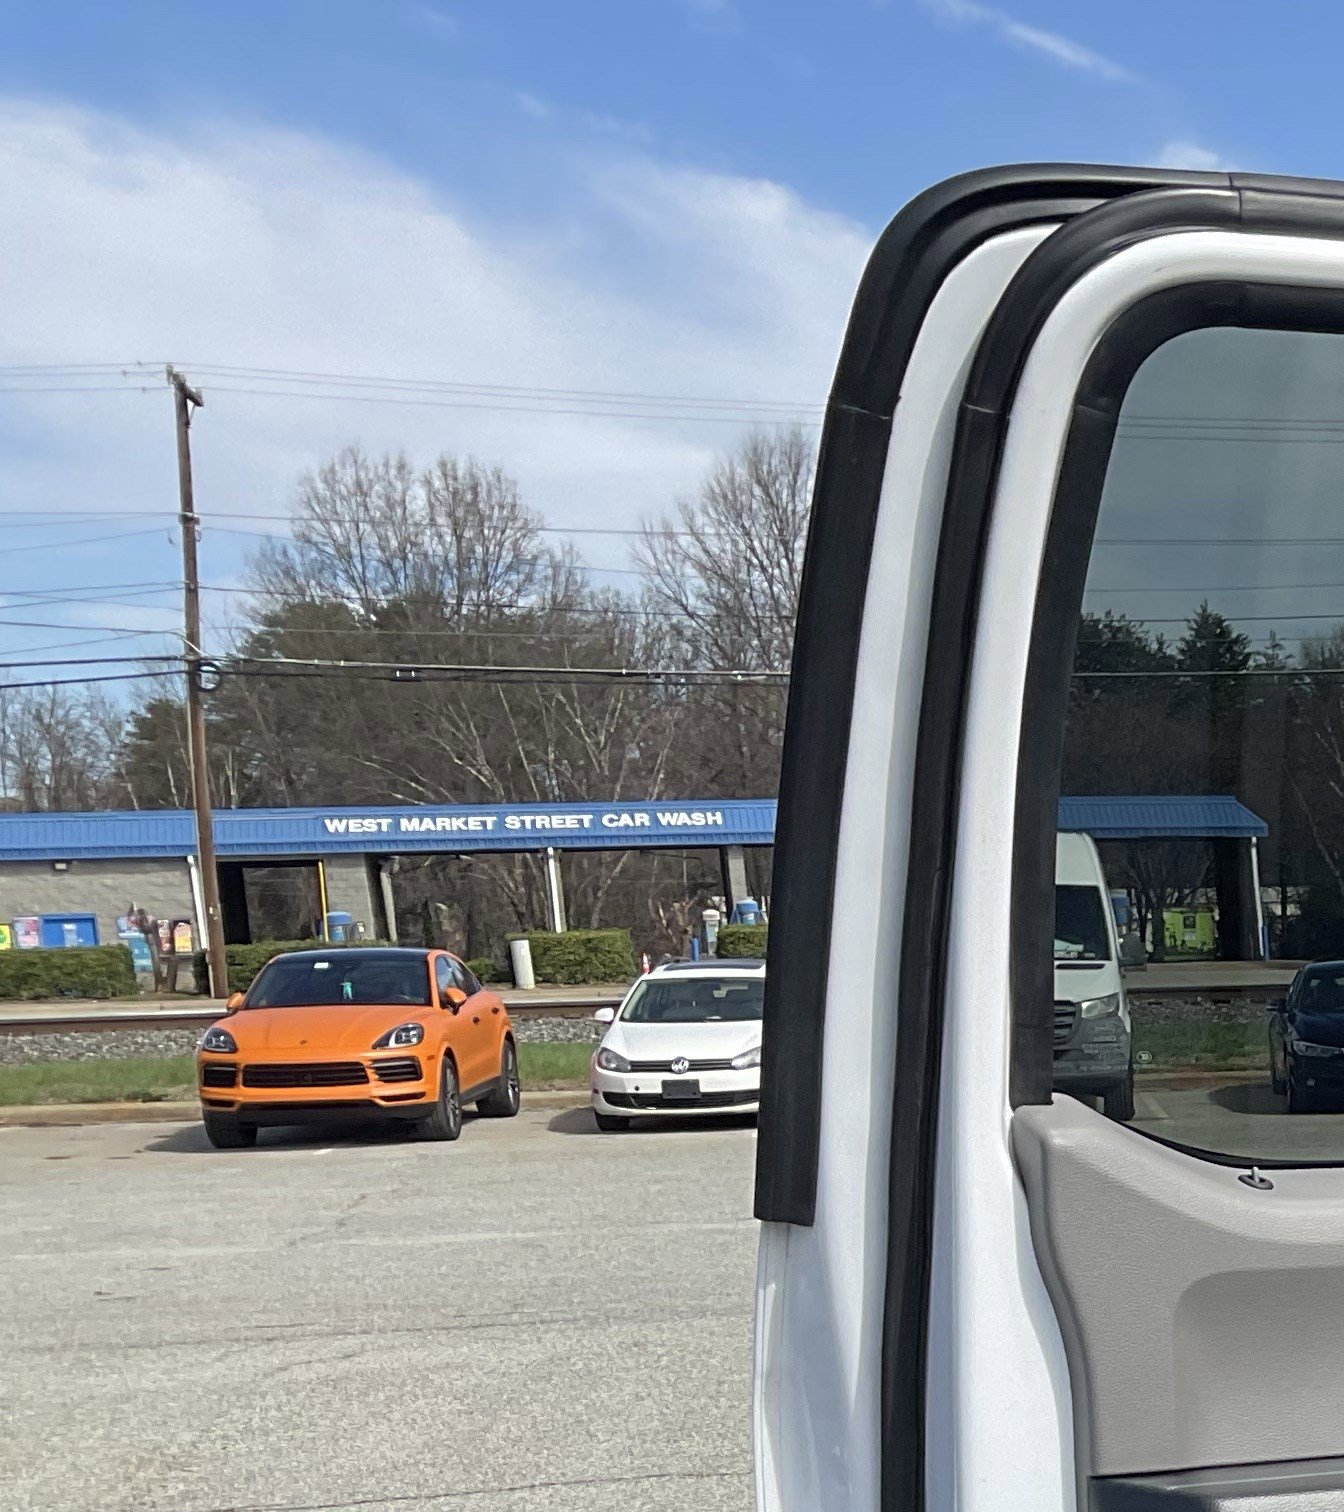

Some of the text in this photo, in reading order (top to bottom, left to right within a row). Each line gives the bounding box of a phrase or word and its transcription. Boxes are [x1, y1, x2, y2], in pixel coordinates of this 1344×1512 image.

[324, 811, 722, 833] WEST MARKET STREET CAR WASH
